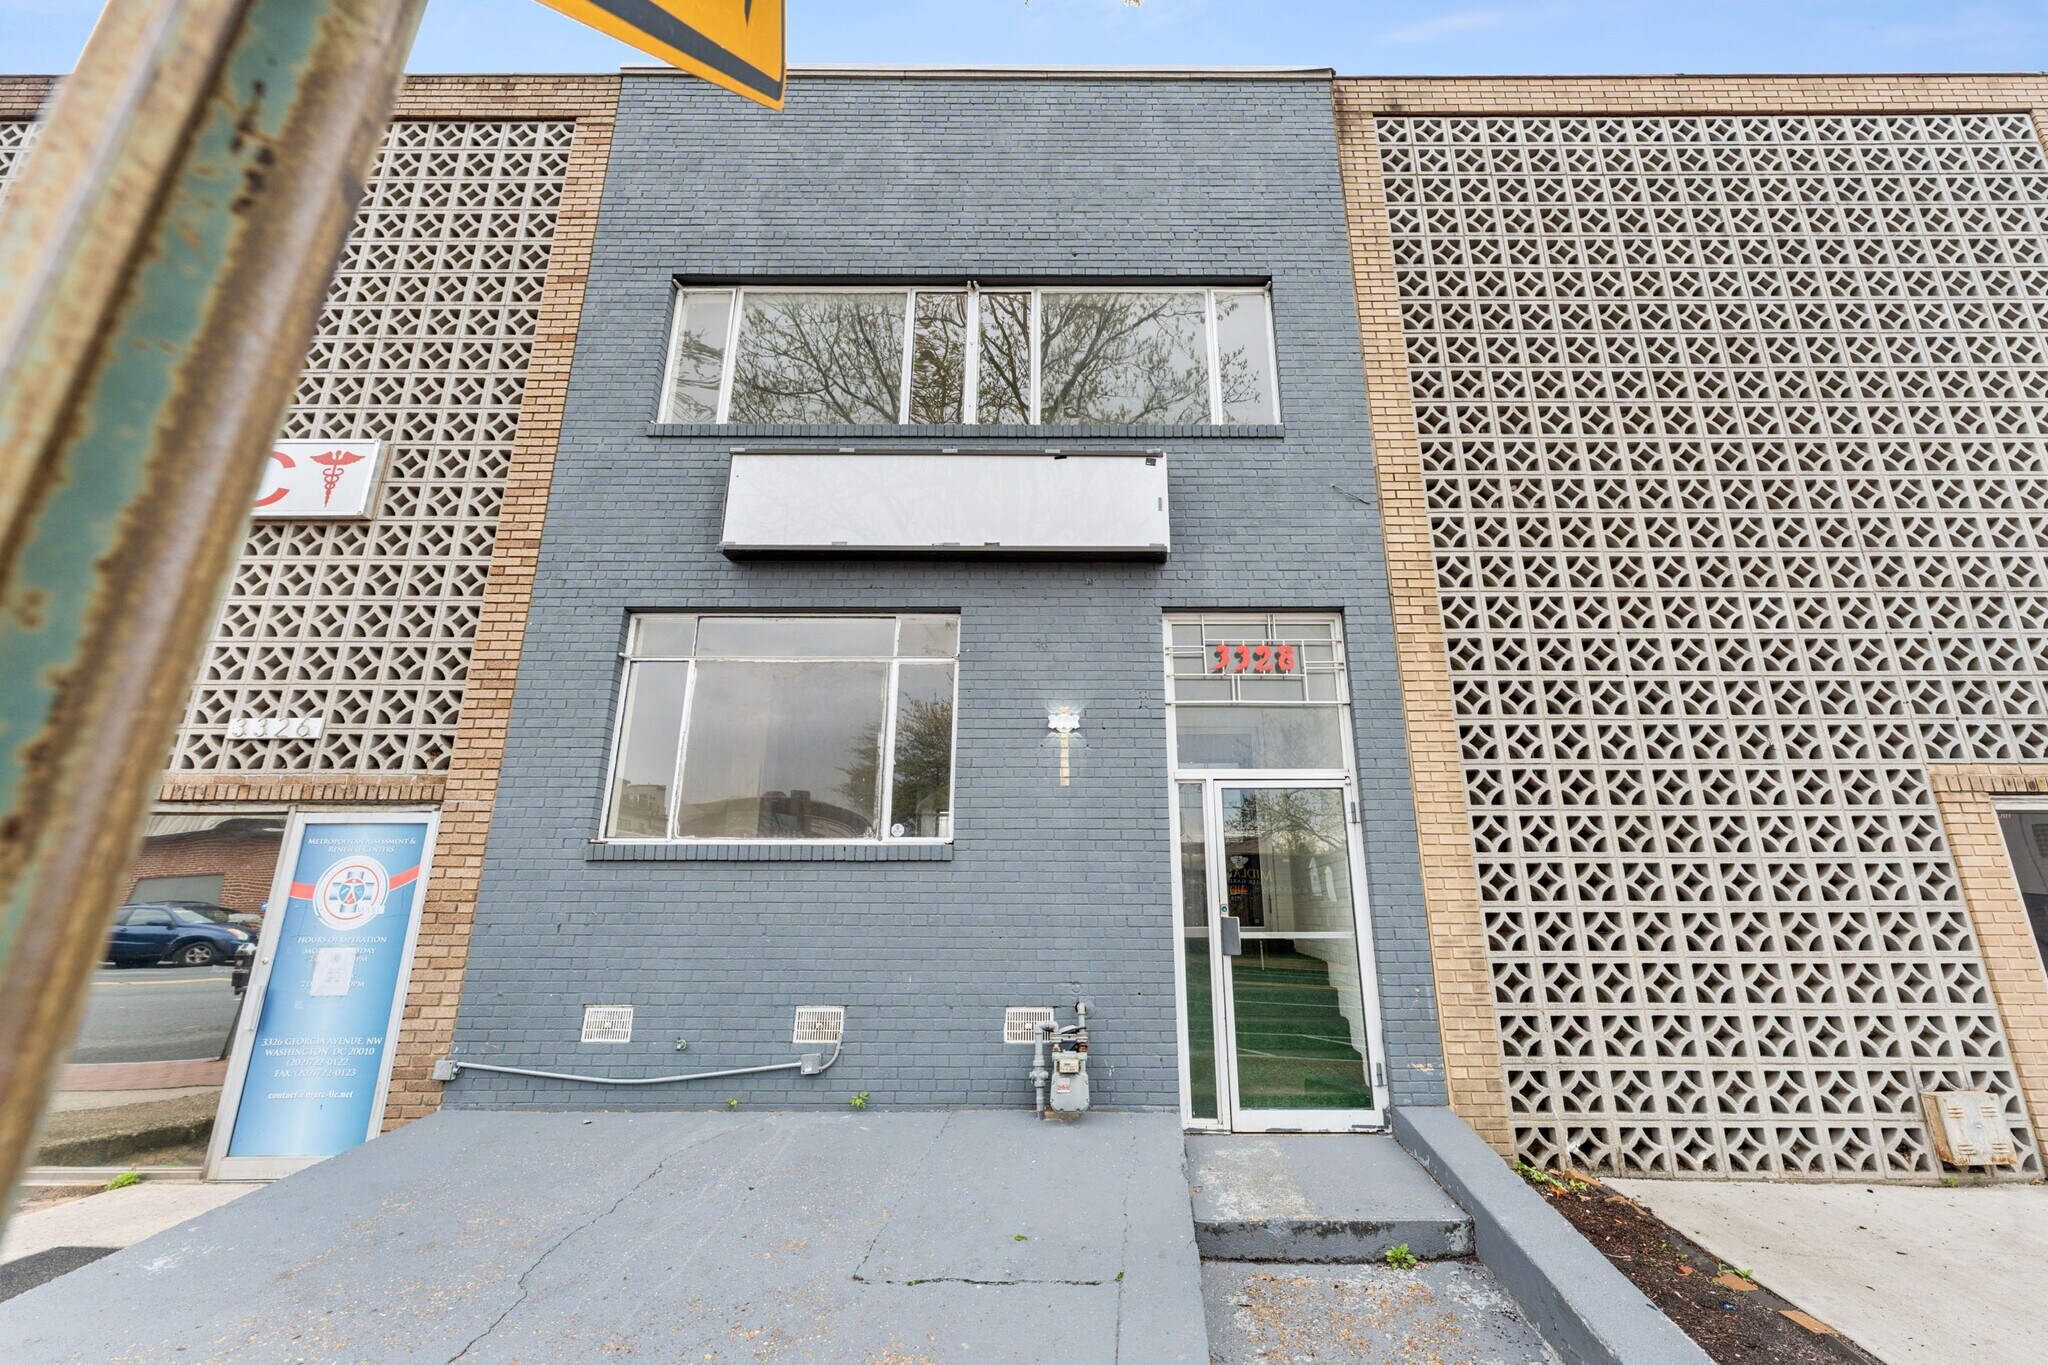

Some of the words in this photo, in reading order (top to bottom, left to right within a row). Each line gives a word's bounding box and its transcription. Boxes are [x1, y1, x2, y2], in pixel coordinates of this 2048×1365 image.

[1208, 644, 1295, 672] 3328
[232, 718, 311, 737] 3326
[297, 936, 326, 944] HOURS
[261, 1038, 283, 1047] 3326
[284, 1037, 326, 1046] GEORGIA
[366, 1037, 384, 1045] NW
[333, 1048, 347, 1056] DC
[348, 1047, 375, 1056] 20010
